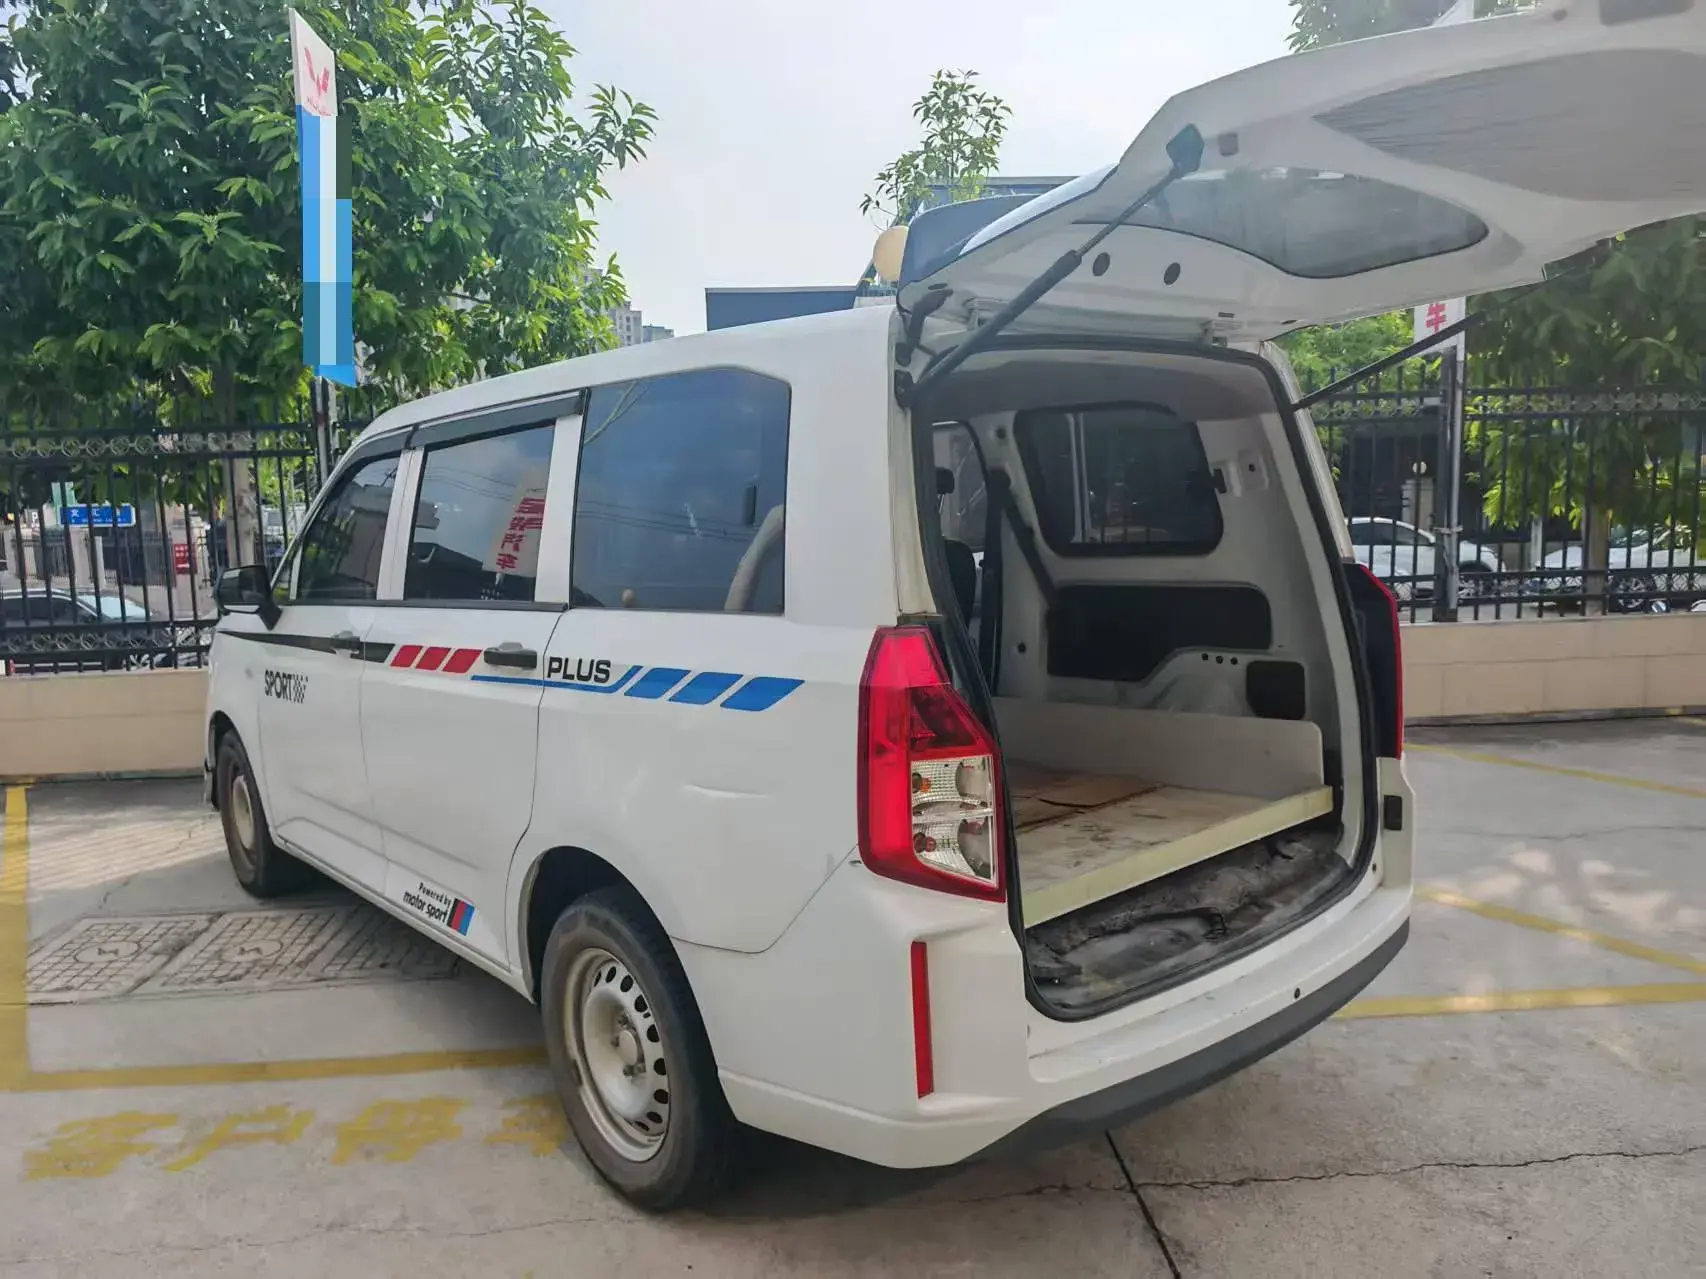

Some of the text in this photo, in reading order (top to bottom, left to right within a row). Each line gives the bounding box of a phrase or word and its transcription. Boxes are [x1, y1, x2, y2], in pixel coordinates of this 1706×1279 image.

[547, 656, 611, 683] PLUS
[264, 669, 292, 701] SPORT
[403, 891, 448, 922] motor sport
[419, 882, 451, 908] Powered by
